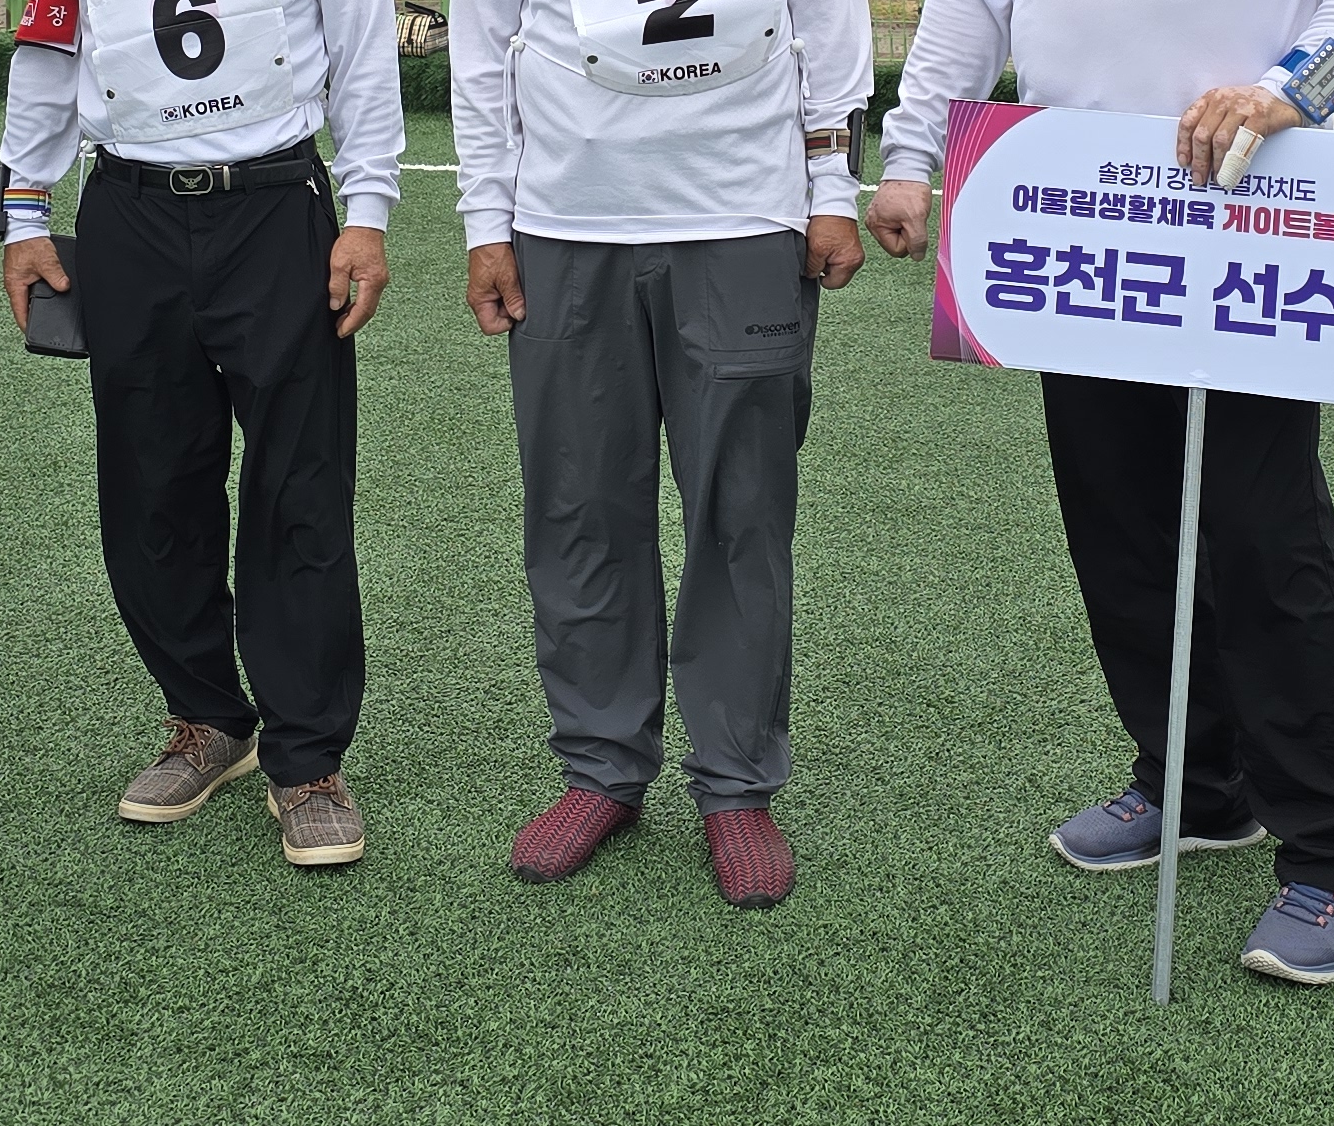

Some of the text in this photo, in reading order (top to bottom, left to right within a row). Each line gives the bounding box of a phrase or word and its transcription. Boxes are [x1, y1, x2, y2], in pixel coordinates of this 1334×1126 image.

[46, 5, 68, 27] 장
[659, 62, 722, 82] KOREA
[181, 93, 245, 119] KOREA
[1098, 160, 1162, 189] 솔향기
[1011, 184, 1216, 231] 어울림생활체육
[984, 237, 1189, 328] 홍천군
